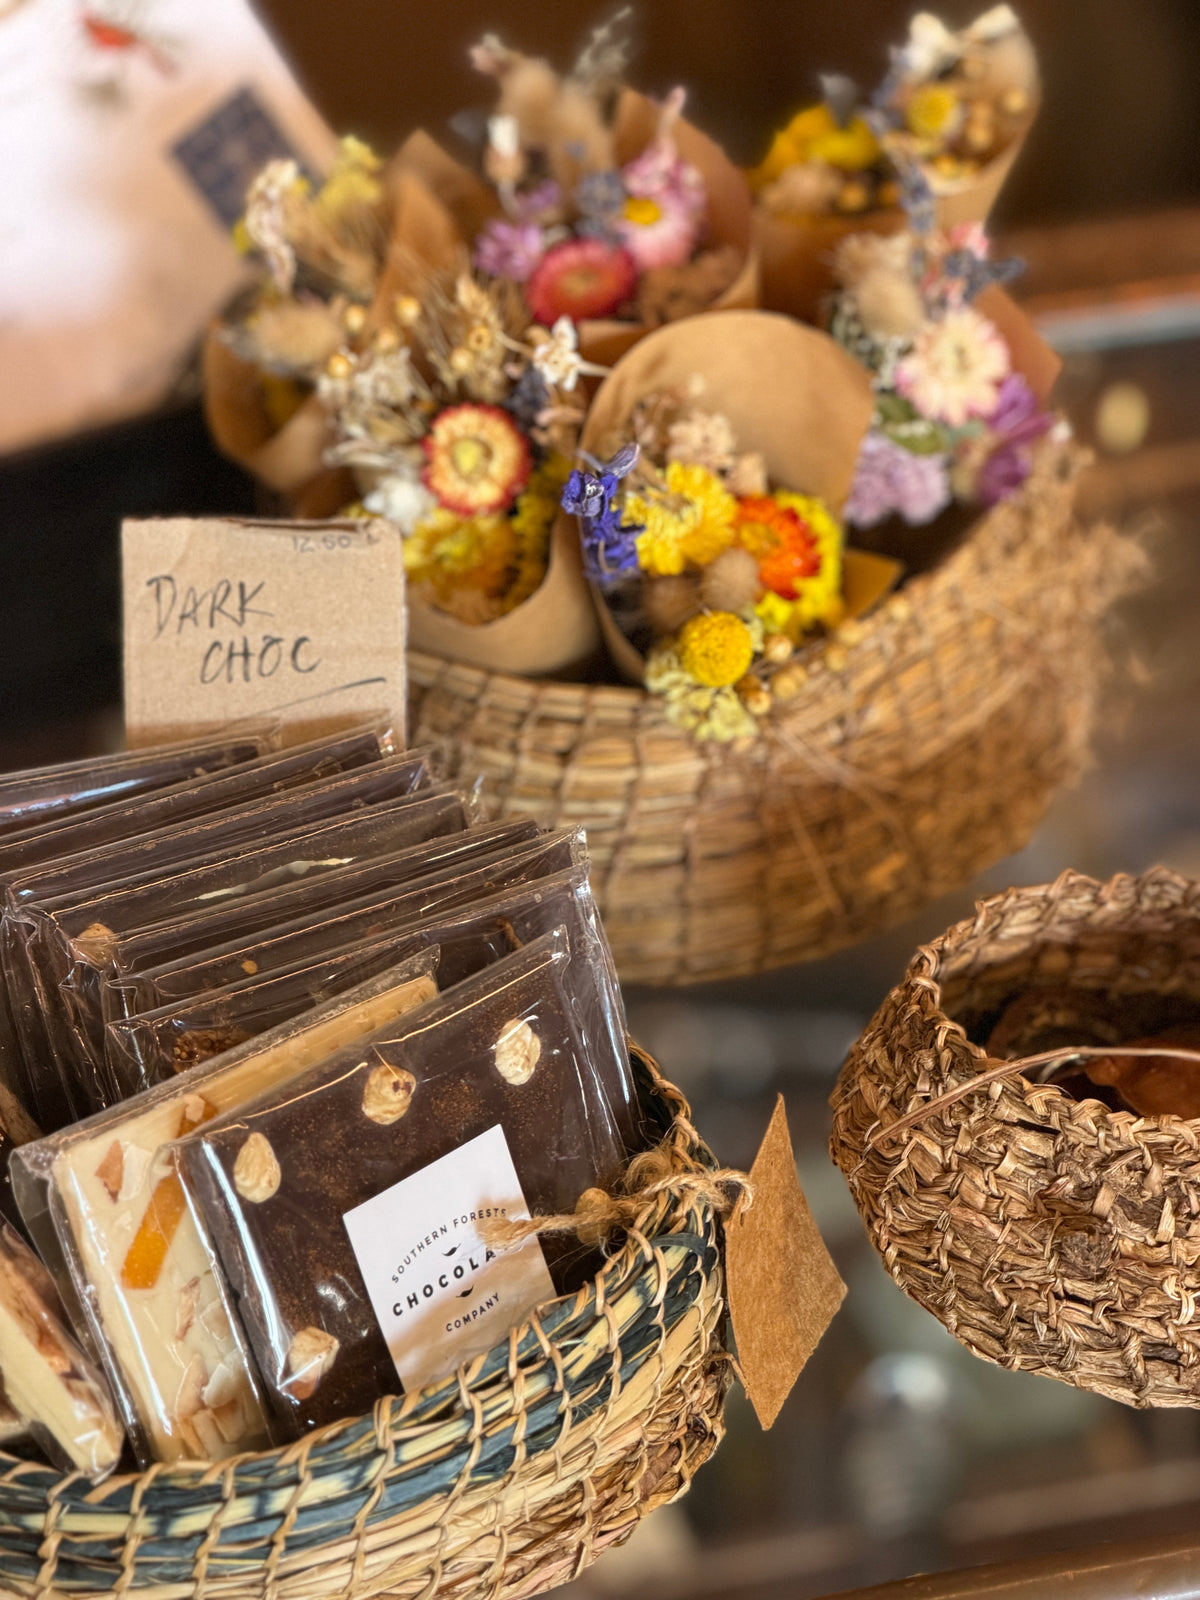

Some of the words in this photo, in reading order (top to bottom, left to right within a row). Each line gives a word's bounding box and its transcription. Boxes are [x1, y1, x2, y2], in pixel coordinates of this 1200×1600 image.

[146, 574, 276, 640] DARK
[200, 635, 322, 684] CHOC
[391, 1225, 448, 1283] SOUTHERN
[392, 1247, 508, 1317] CHOCOLA
[445, 1292, 501, 1332] COMPANY
